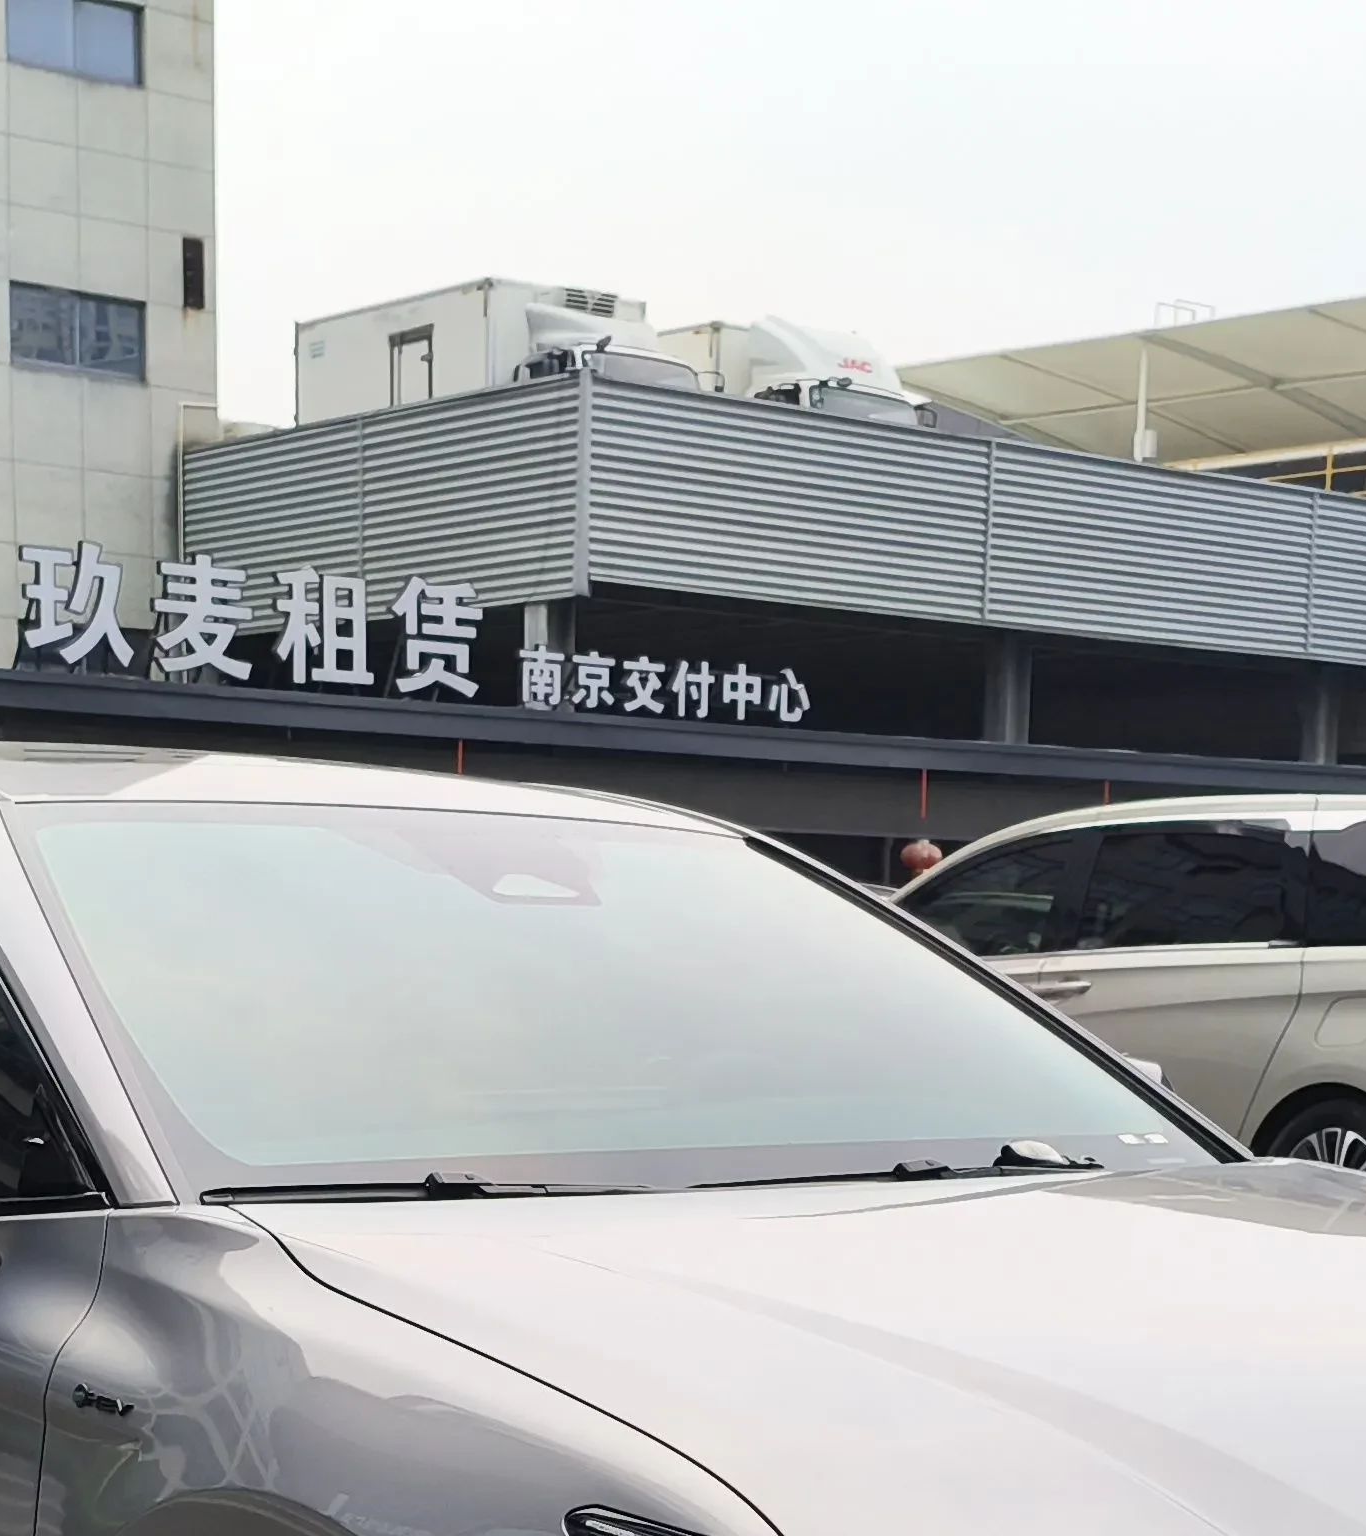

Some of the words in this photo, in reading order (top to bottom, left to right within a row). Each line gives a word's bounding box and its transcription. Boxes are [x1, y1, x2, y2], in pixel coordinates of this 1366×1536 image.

[20, 541, 484, 699] 玖麦租赁
[519, 644, 809, 724] 南京交付中心
